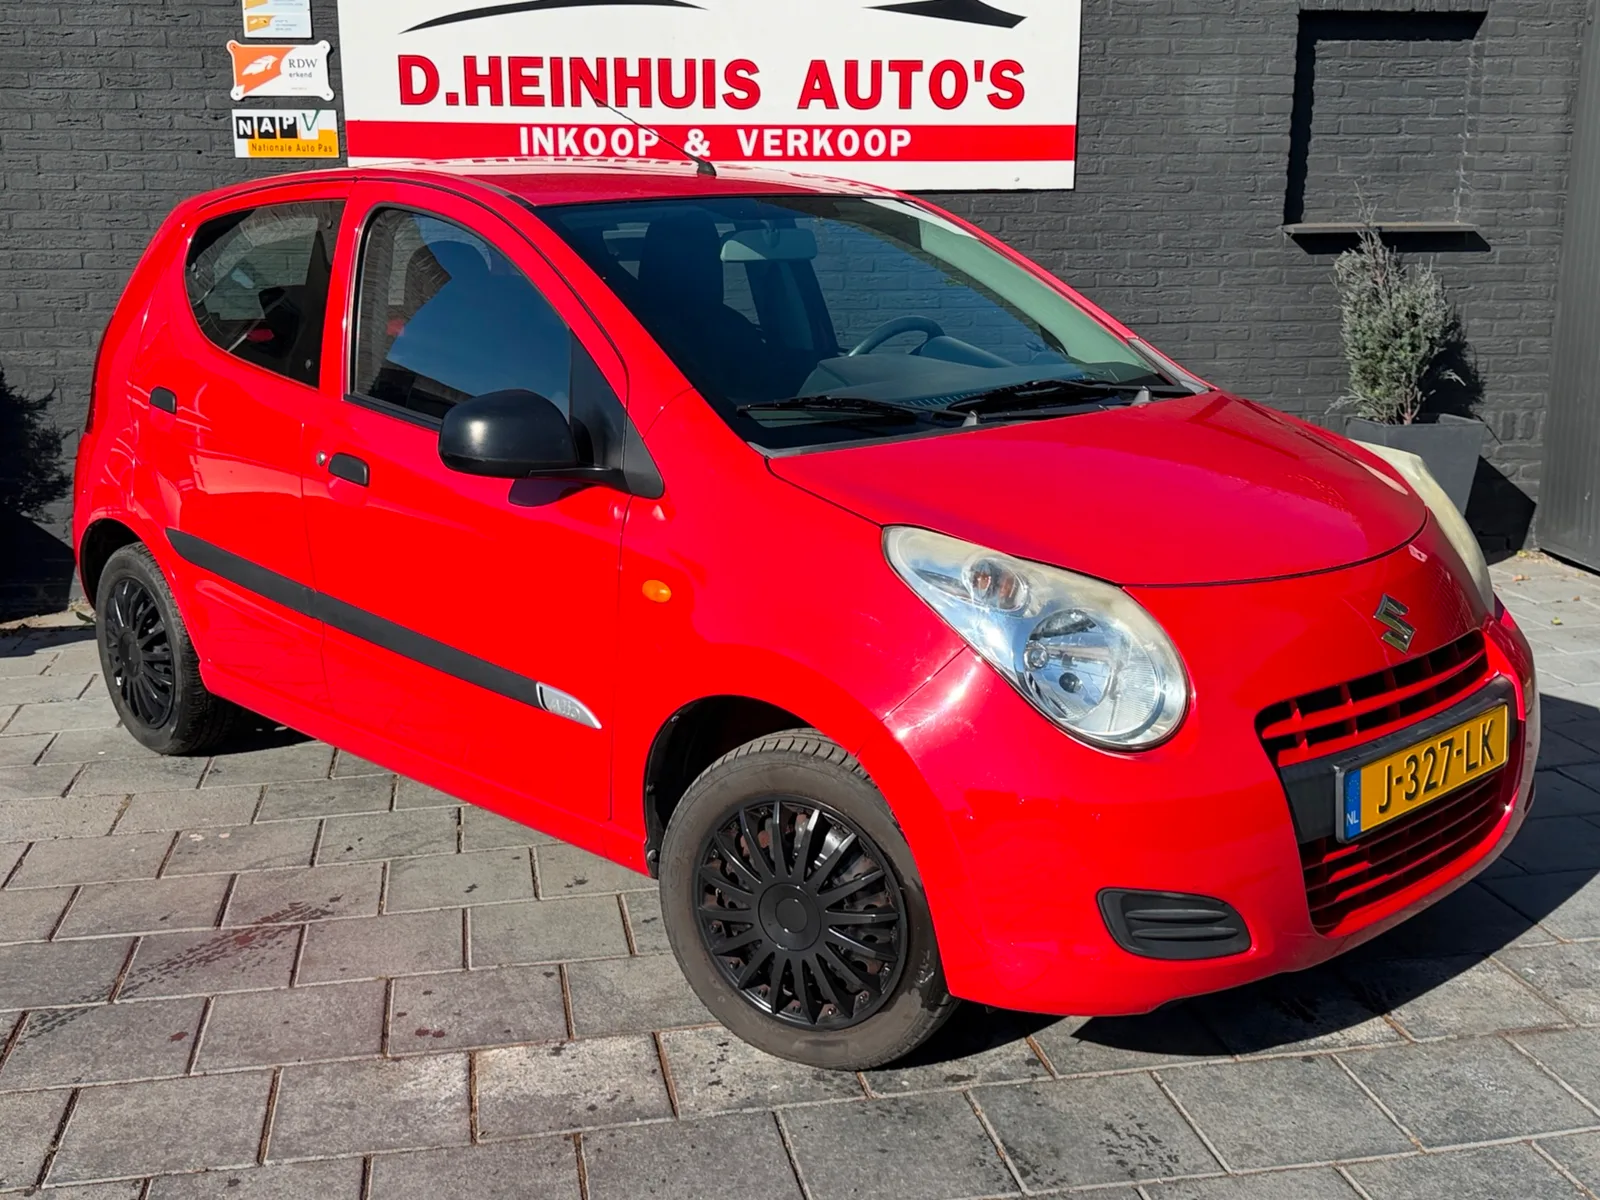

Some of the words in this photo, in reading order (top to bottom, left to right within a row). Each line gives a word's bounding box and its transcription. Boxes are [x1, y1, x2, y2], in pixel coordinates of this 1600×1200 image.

[288, 58, 318, 69] RDW
[289, 71, 313, 79] erkend
[398, 54, 762, 110] D.HEINHUIS
[796, 59, 1026, 111] AUTO'S
[251, 142, 293, 153] Nationale
[295, 143, 316, 153] Auto
[317, 143, 333, 153] Pas
[519, 126, 660, 157] INKOOP
[683, 128, 711, 157] &
[736, 128, 912, 158] VERKOOP
[1376, 717, 1495, 814] J-327-LK
[1346, 810, 1360, 826] NL
